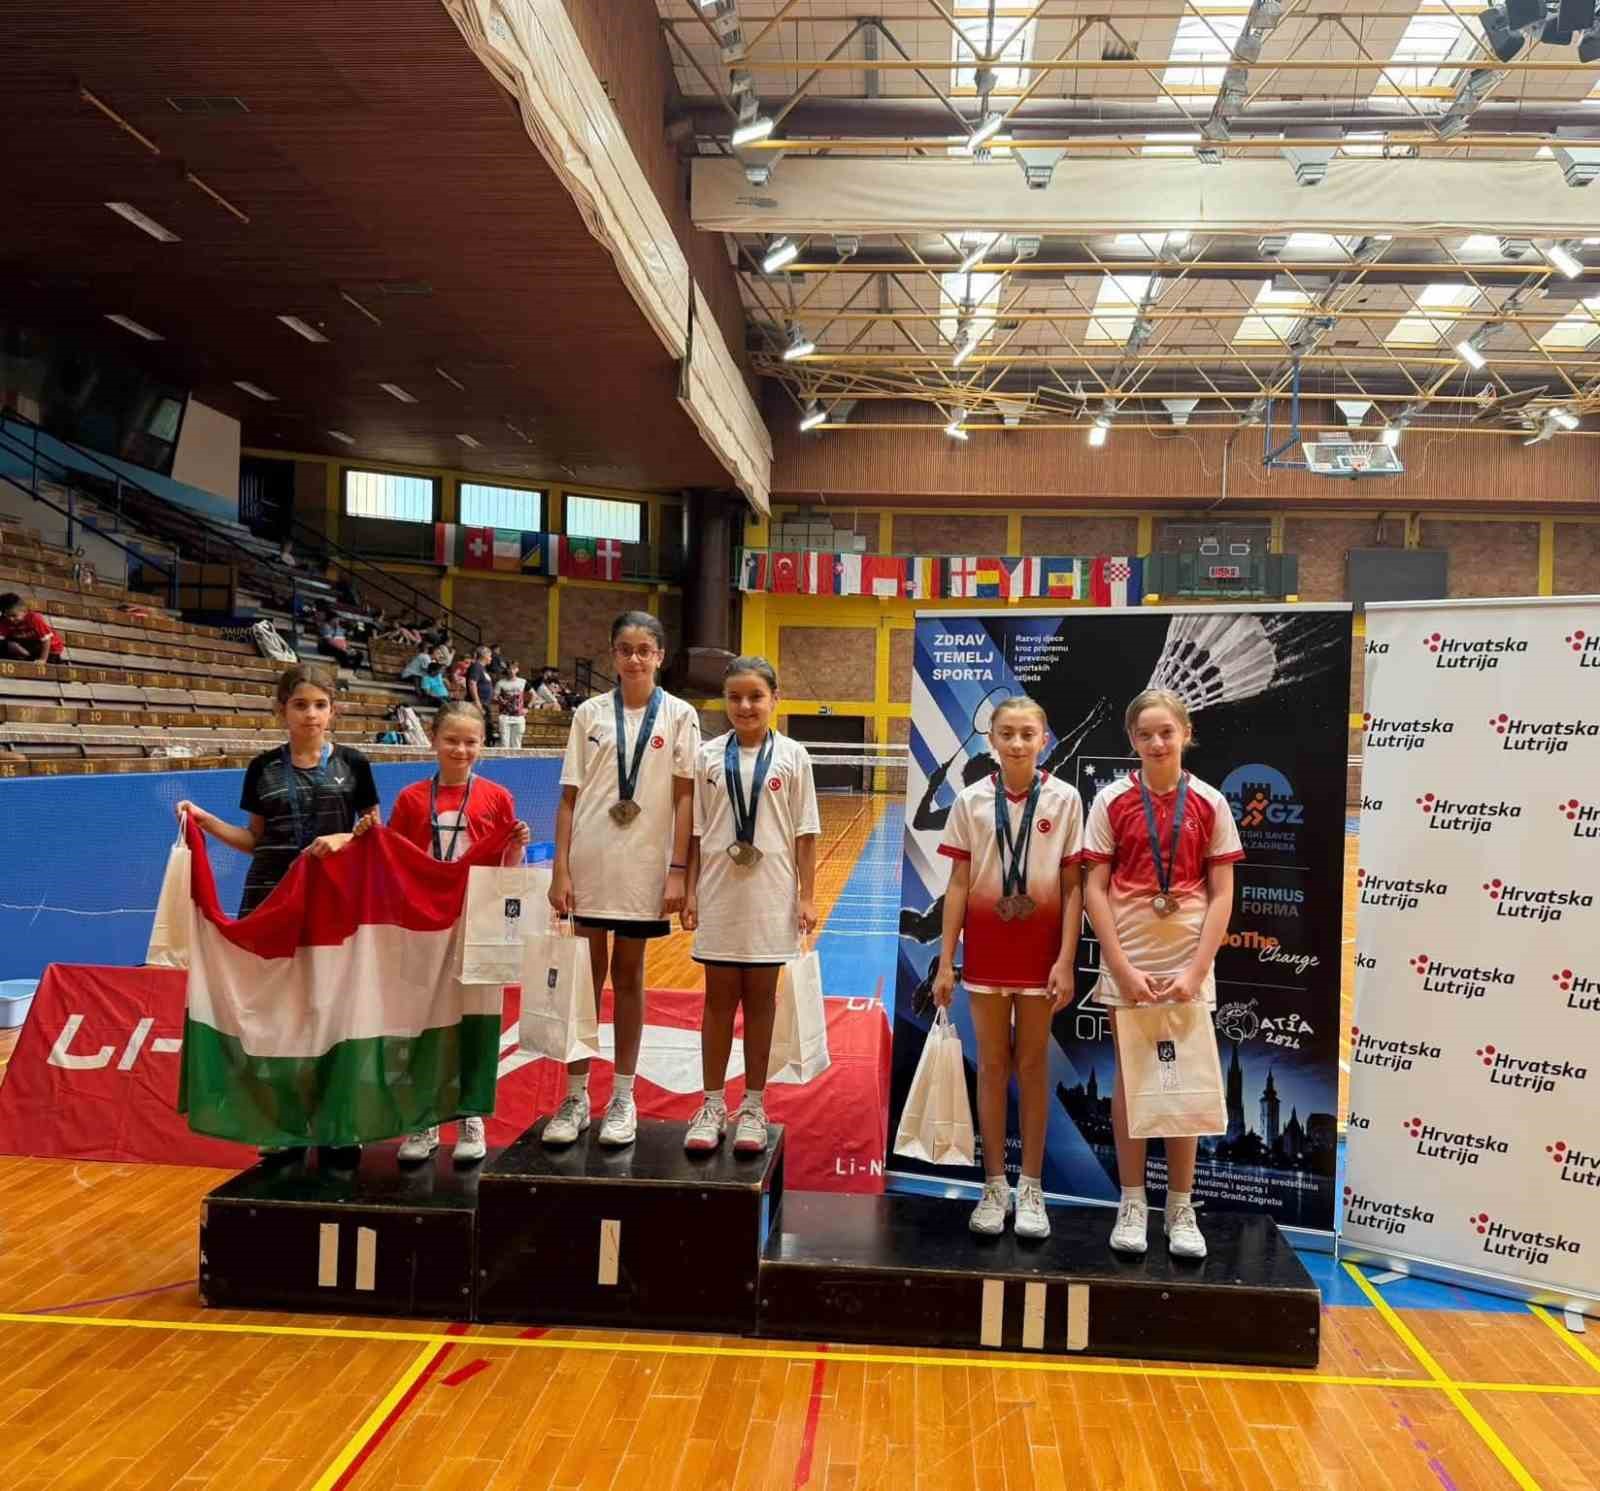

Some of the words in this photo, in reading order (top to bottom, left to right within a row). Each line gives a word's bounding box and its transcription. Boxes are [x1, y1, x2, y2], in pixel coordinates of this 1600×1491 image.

[934, 634, 986, 646] ZDRAV
[1440, 637, 1528, 653] Hrvatska
[1584, 636, 1600, 651] H
[934, 651, 994, 663] TEMELJ
[1436, 654, 1498, 671] Lutrija
[932, 668, 994, 681] SPORTA
[1371, 718, 1454, 733] Hrvatska
[1507, 720, 1599, 736] Hrvatska
[1367, 734, 1425, 751] Lutrija
[1503, 737, 1568, 754] Lutrija
[1434, 800, 1521, 817] Hrvatska
[1430, 815, 1492, 834] Lutrija
[1365, 875, 1447, 895] Hrvatska
[1242, 887, 1304, 903] FIRMUS
[1361, 891, 1419, 910] Lutrija
[1501, 886, 1593, 907] Hrvatska
[1242, 902, 1299, 917] FORMA
[1497, 902, 1562, 923] Lutrija
[1258, 945, 1320, 974] Change
[1427, 962, 1515, 985] Hrvatska
[1423, 977, 1486, 999] Lutrija
[1358, 1034, 1441, 1058] Hrvatska
[1355, 1050, 1412, 1072] Lutrija
[1494, 1053, 1587, 1079] Hrvatska
[1490, 1069, 1555, 1093] Lutrija
[1421, 1125, 1509, 1153] Hrvatska
[1416, 1141, 1479, 1165] Lutrija
[836, 1157, 884, 1176] Li-N
[1198, 1178, 1229, 1189] turizma
[1351, 1194, 1434, 1223] Hrvatska
[1347, 1209, 1406, 1234] Lutrija
[1488, 1222, 1581, 1253] Hrvatska
[1484, 1238, 1549, 1265] Lutrija
